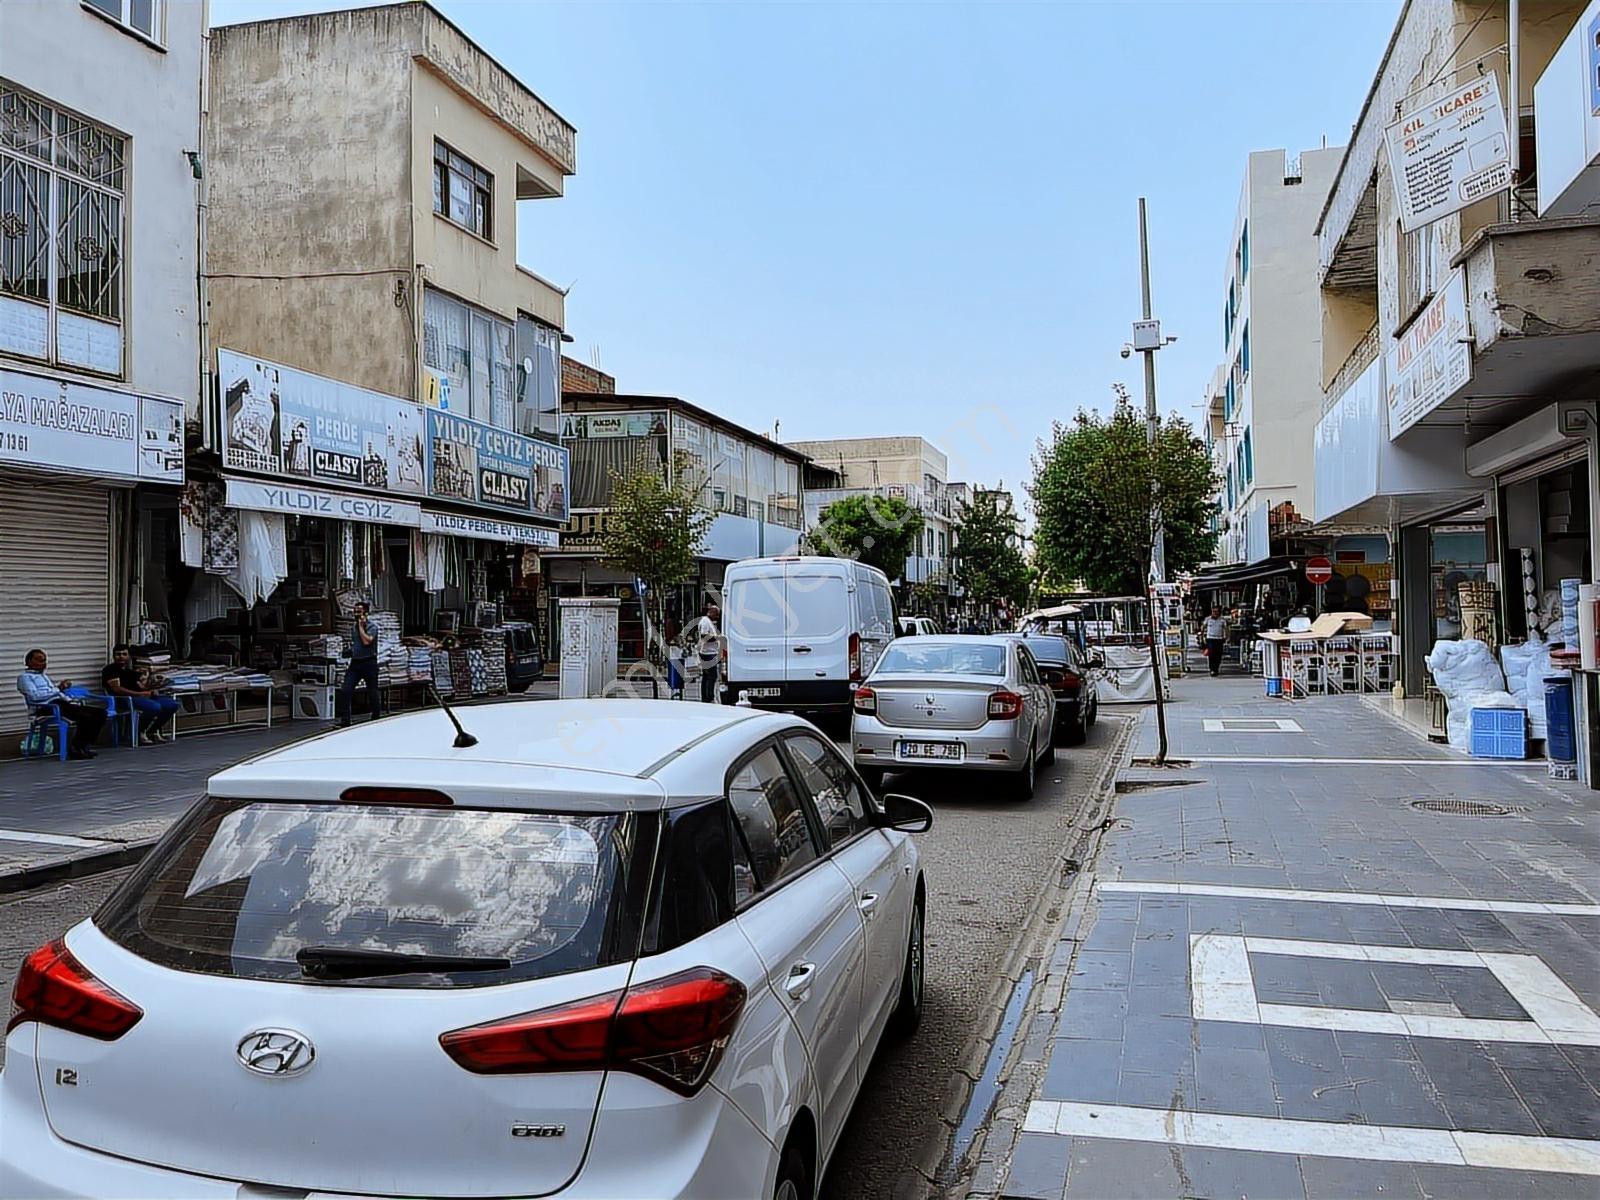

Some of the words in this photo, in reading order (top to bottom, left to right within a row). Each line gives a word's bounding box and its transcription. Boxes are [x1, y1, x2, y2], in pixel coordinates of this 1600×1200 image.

[31, 395, 134, 440] MAĞAZALARI
[315, 415, 358, 443] PERDE
[433, 414, 482, 448] YILDIZ
[486, 431, 522, 459] ÇEYİZ
[526, 443, 564, 469] PERDE
[316, 452, 359, 475] CLASY
[482, 470, 528, 501] CLASY
[264, 489, 332, 512] YILDIZ
[433, 514, 466, 529] YILDIZ
[469, 520, 499, 534] PERDE
[501, 524, 511, 535] EV
